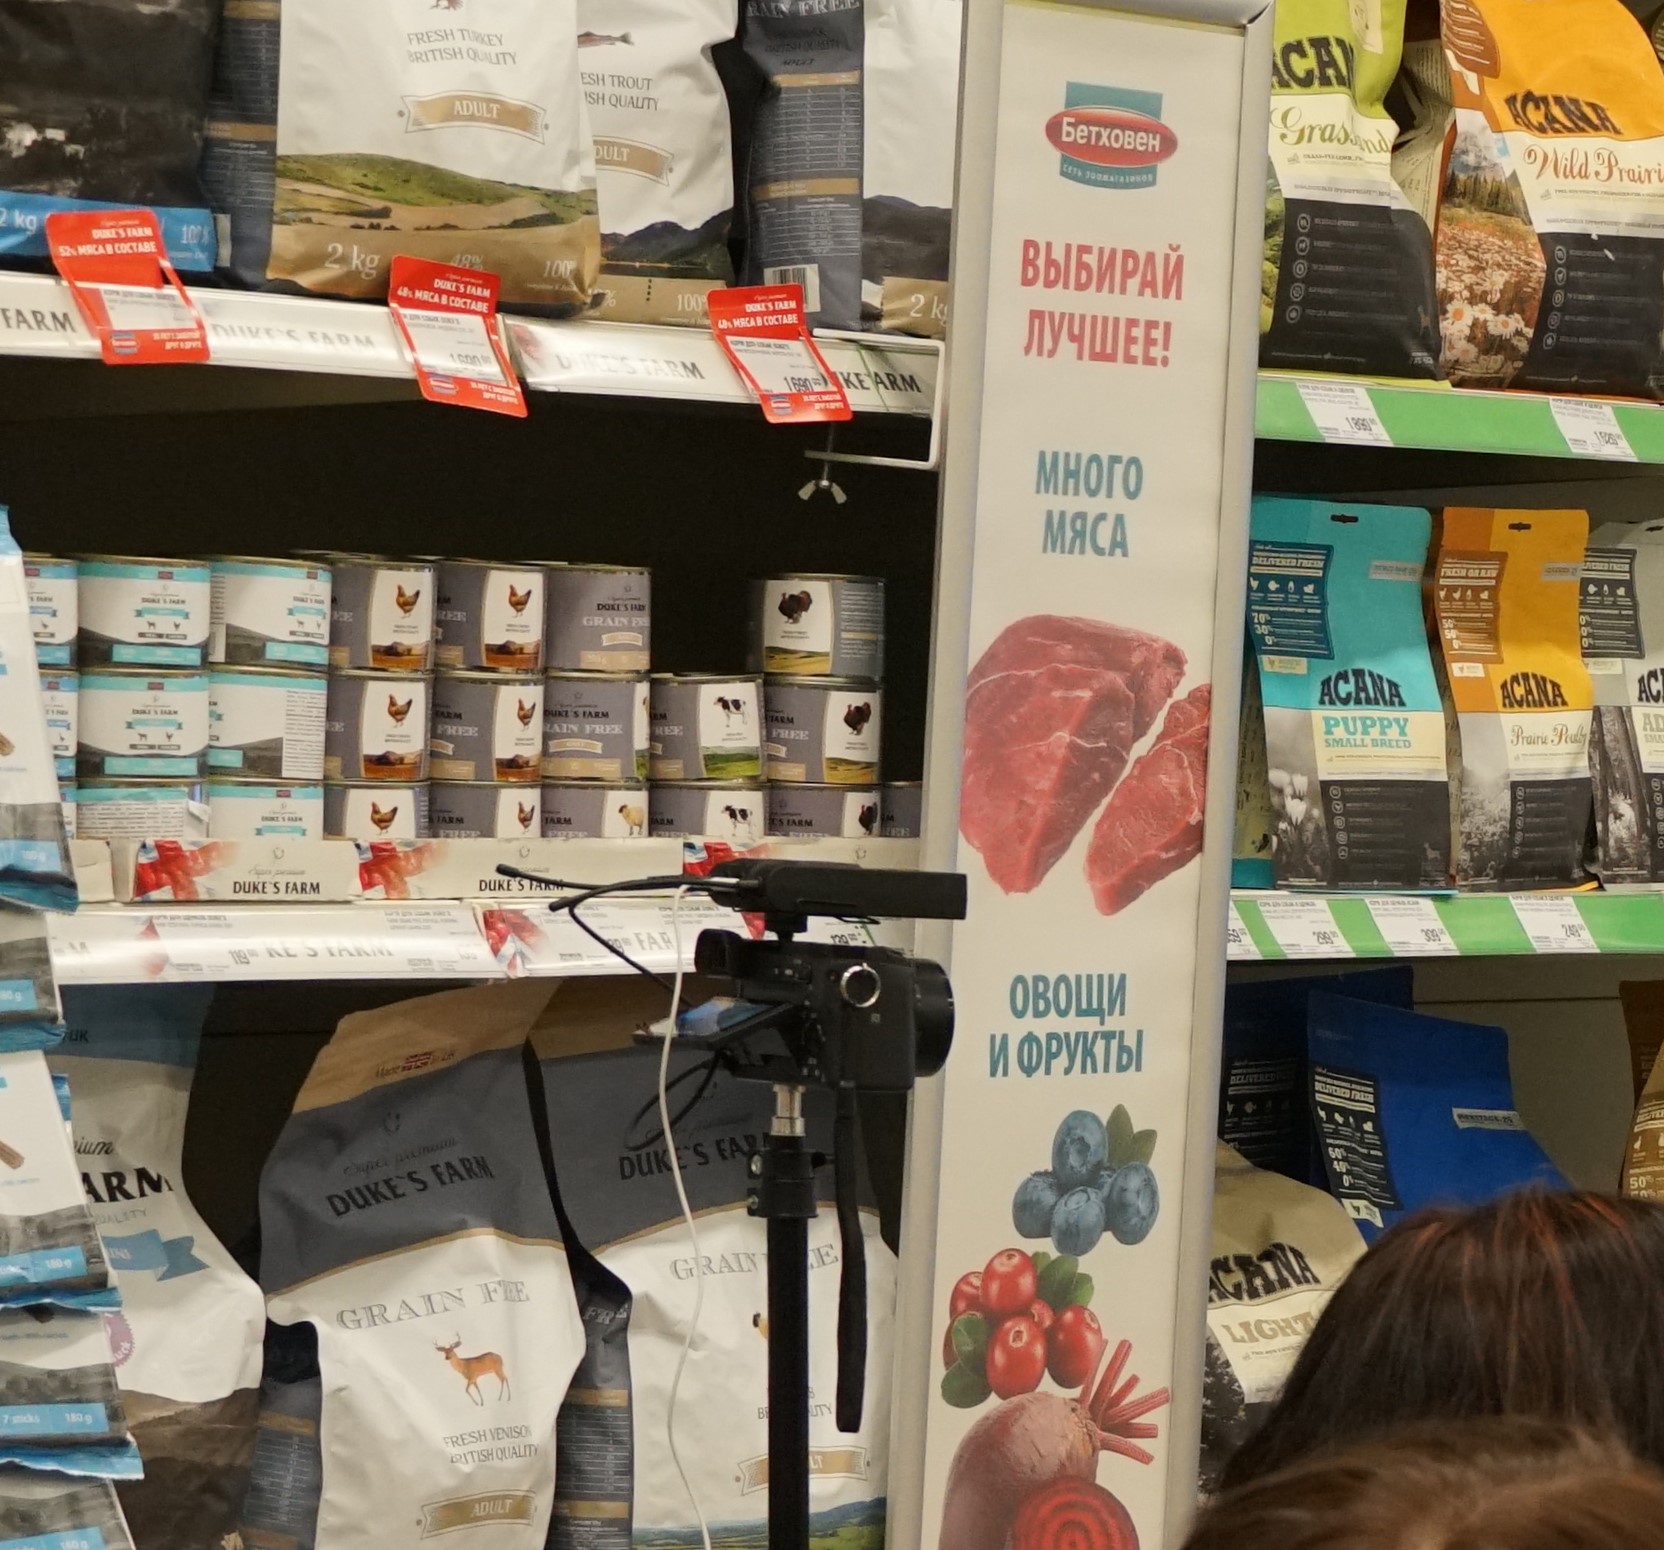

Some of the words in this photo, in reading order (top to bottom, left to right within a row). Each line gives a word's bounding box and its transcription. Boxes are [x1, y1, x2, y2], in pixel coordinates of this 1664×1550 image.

[407, 29, 456, 46] FRESH
[610, 75, 653, 91] TROUT
[453, 100, 500, 118] ADULT
[609, 93, 660, 112] QUALITY
[1505, 90, 1622, 135] ACANA
[1060, 116, 1160, 153] Бетховен
[1523, 144, 1591, 182] Wild
[114, 241, 157, 254] СОСТАВЕ
[351, 245, 380, 278] kg
[1020, 239, 1184, 301] ВЫБИРАЙ
[448, 296, 489, 314] СОСТАВЕ
[1023, 308, 1172, 368] ЛУЧШЕЕ!
[1035, 450, 1143, 501] МНОГО
[1041, 509, 1129, 558] МЯСА
[1318, 668, 1406, 708] ACANA
[1500, 671, 1569, 708] ACANA
[1323, 715, 1409, 739] PUPPY
[1325, 737, 1367, 749] SMALL
[1371, 738, 1412, 749] BREED
[284, 881, 320, 895] FARM
[1009, 973, 1127, 1026] ОВОЩИ
[989, 1033, 1009, 1078] И
[1017, 1029, 1143, 1078] ФРУКТЫ
[336, 1288, 465, 1331] GRAIN
[471, 1499, 514, 1517] ADULT
